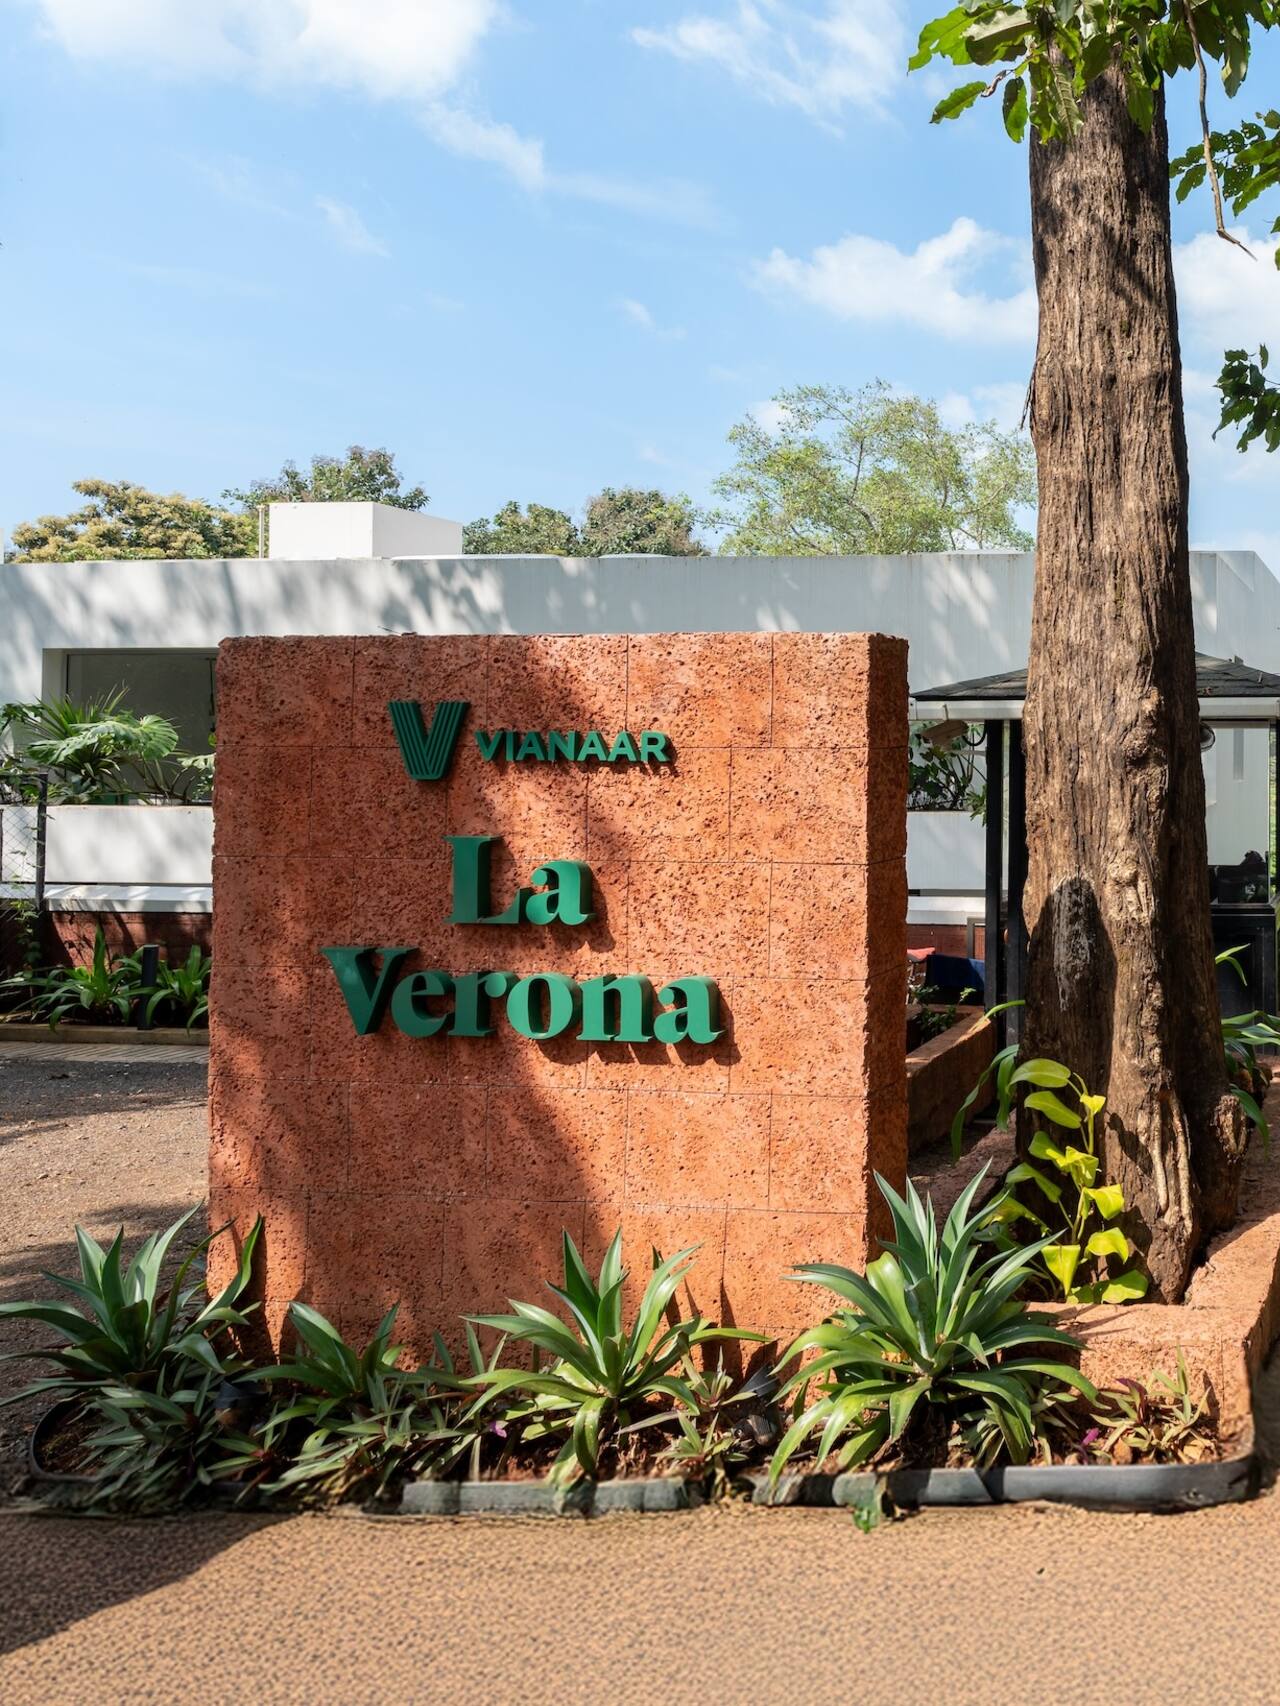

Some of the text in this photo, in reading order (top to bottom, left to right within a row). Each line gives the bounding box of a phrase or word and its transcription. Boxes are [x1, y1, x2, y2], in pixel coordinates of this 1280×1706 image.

[389, 700, 468, 780] V
[475, 730, 671, 763] VIANAAR
[445, 835, 596, 926] La
[323, 946, 726, 1045] Verona
